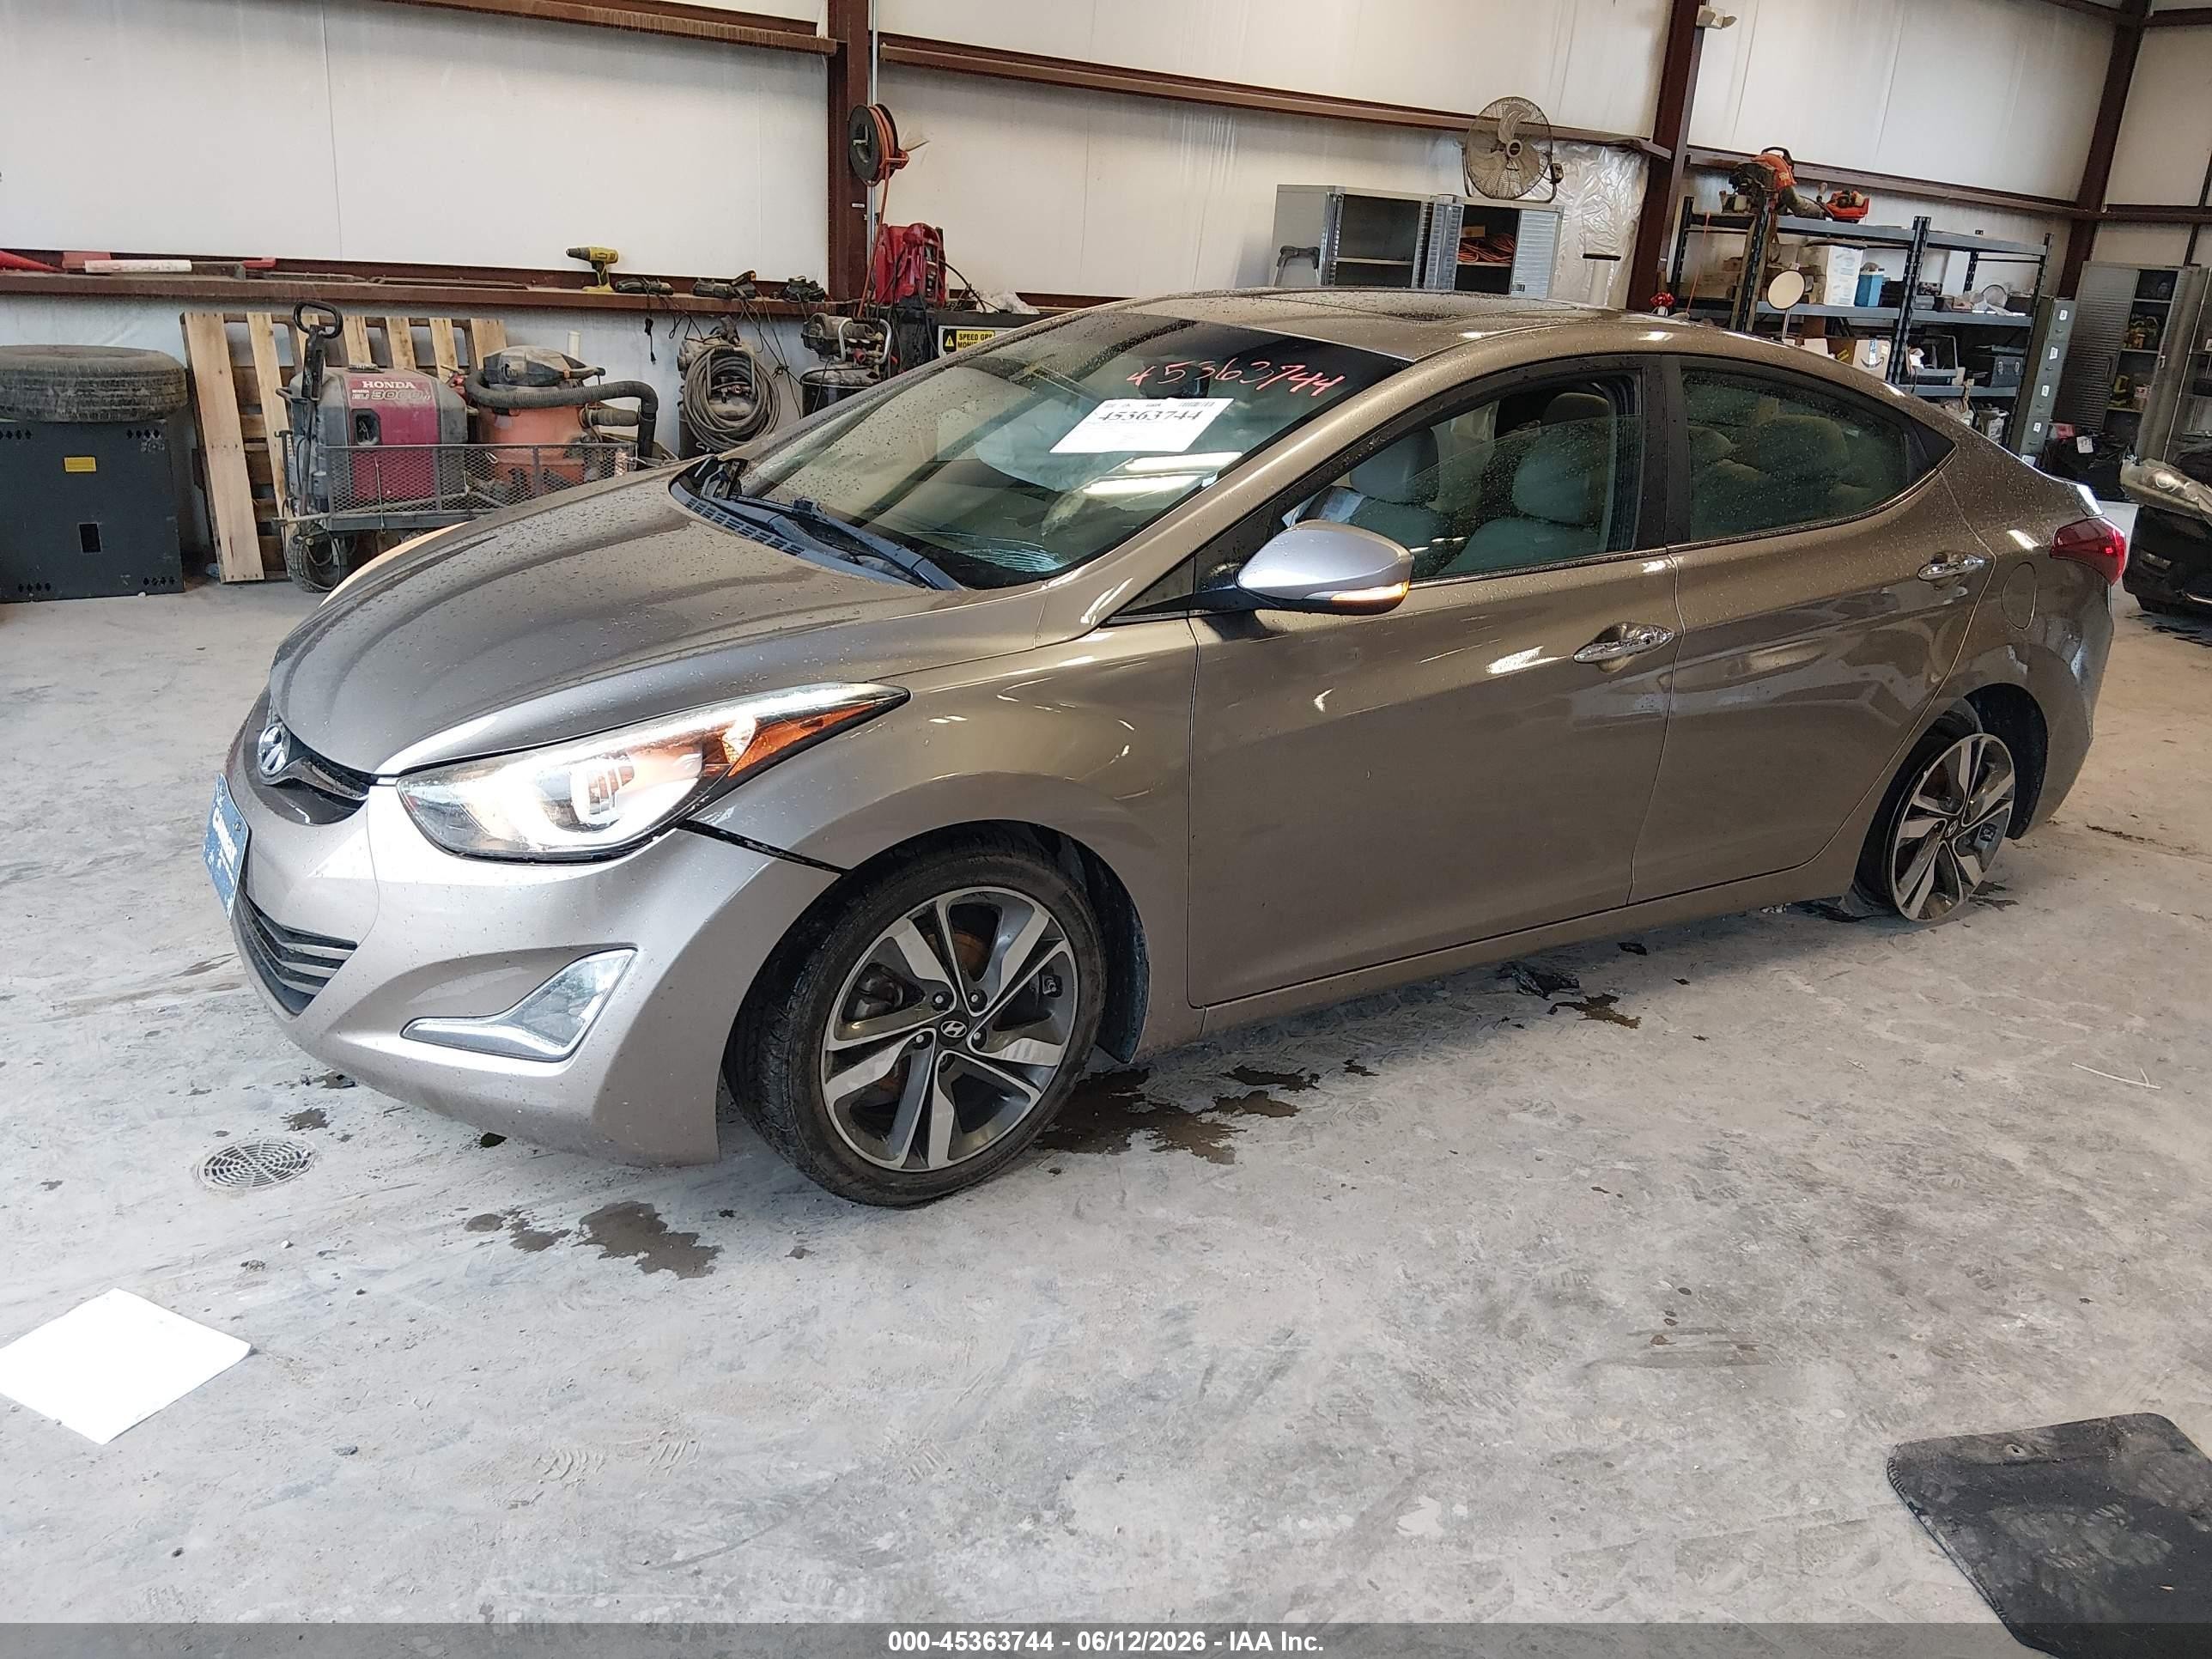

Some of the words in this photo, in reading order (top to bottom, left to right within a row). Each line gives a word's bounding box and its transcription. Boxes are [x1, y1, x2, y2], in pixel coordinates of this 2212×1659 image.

[1126, 357, 1345, 397] 45363744
[362, 380, 416, 389] HONDA
[1098, 410, 1203, 421] 45363744
